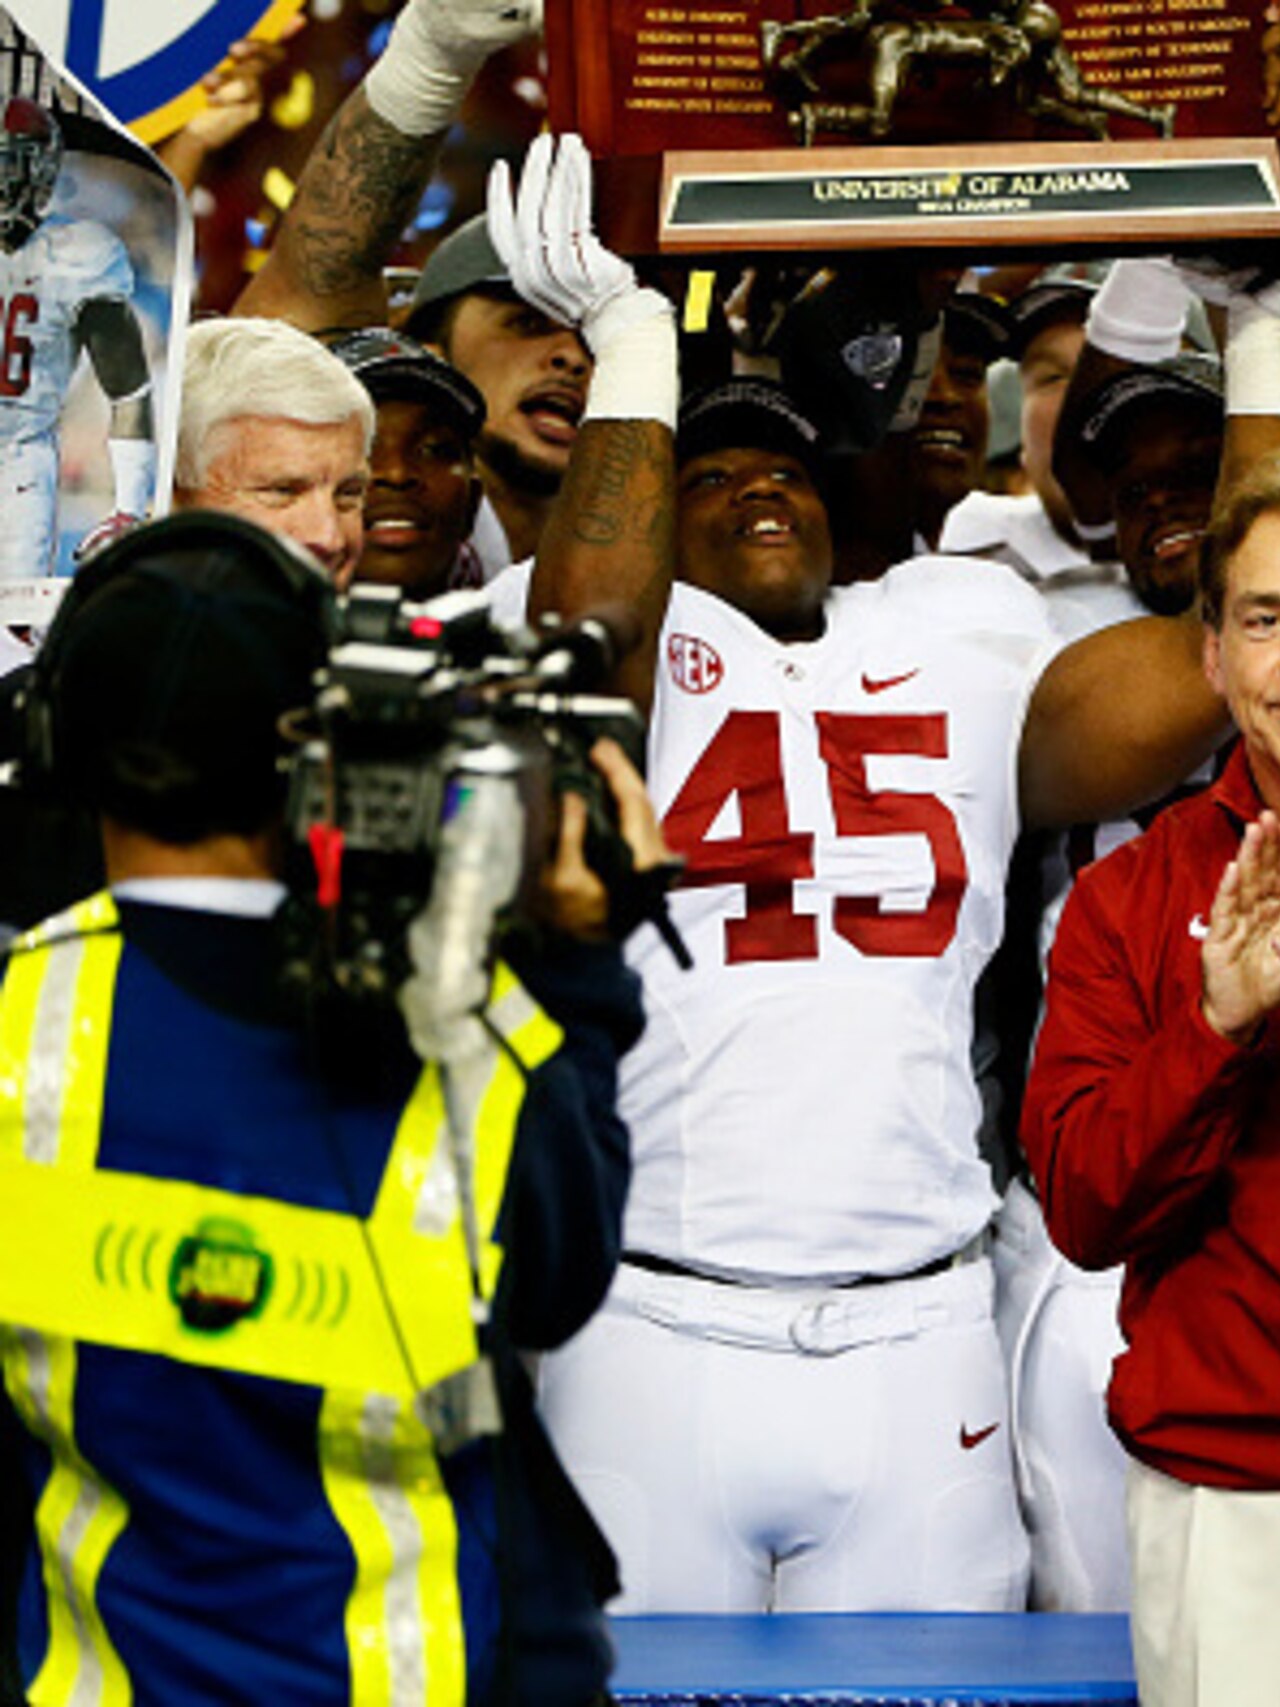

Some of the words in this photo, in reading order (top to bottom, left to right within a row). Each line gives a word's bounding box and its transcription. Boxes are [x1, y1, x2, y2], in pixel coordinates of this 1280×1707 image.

[813, 175, 961, 201] UNIVERSITY
[968, 176, 1003, 196] OF
[1009, 172, 1131, 195] ALABAMA
[660, 709, 969, 965] 45
